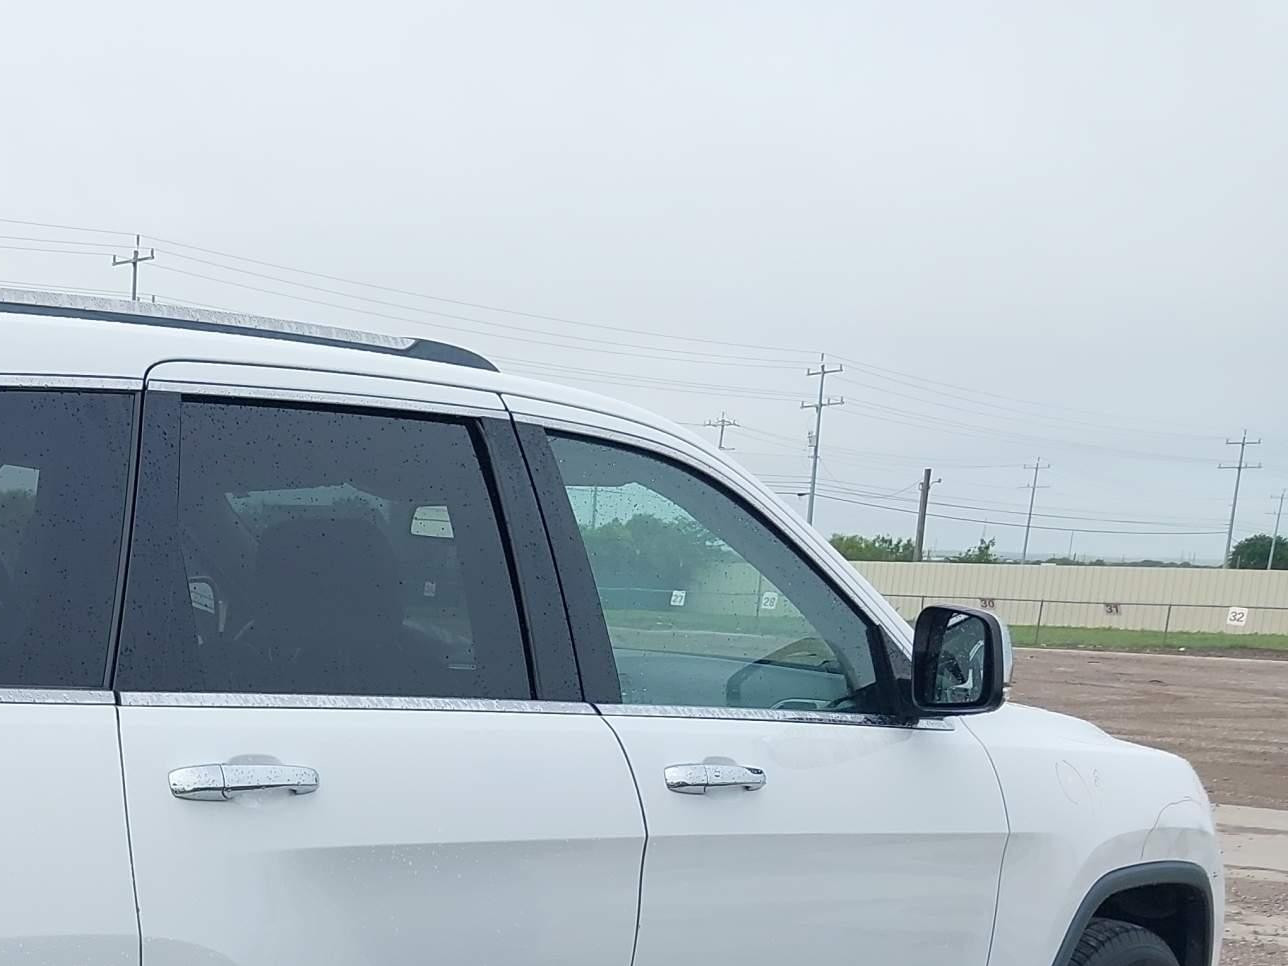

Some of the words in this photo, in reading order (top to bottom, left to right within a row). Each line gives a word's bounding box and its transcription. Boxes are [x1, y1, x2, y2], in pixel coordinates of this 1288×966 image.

[672, 594, 683, 604] 27
[763, 597, 776, 607] 28
[980, 598, 995, 608] 30
[1229, 611, 1245, 622] 32
